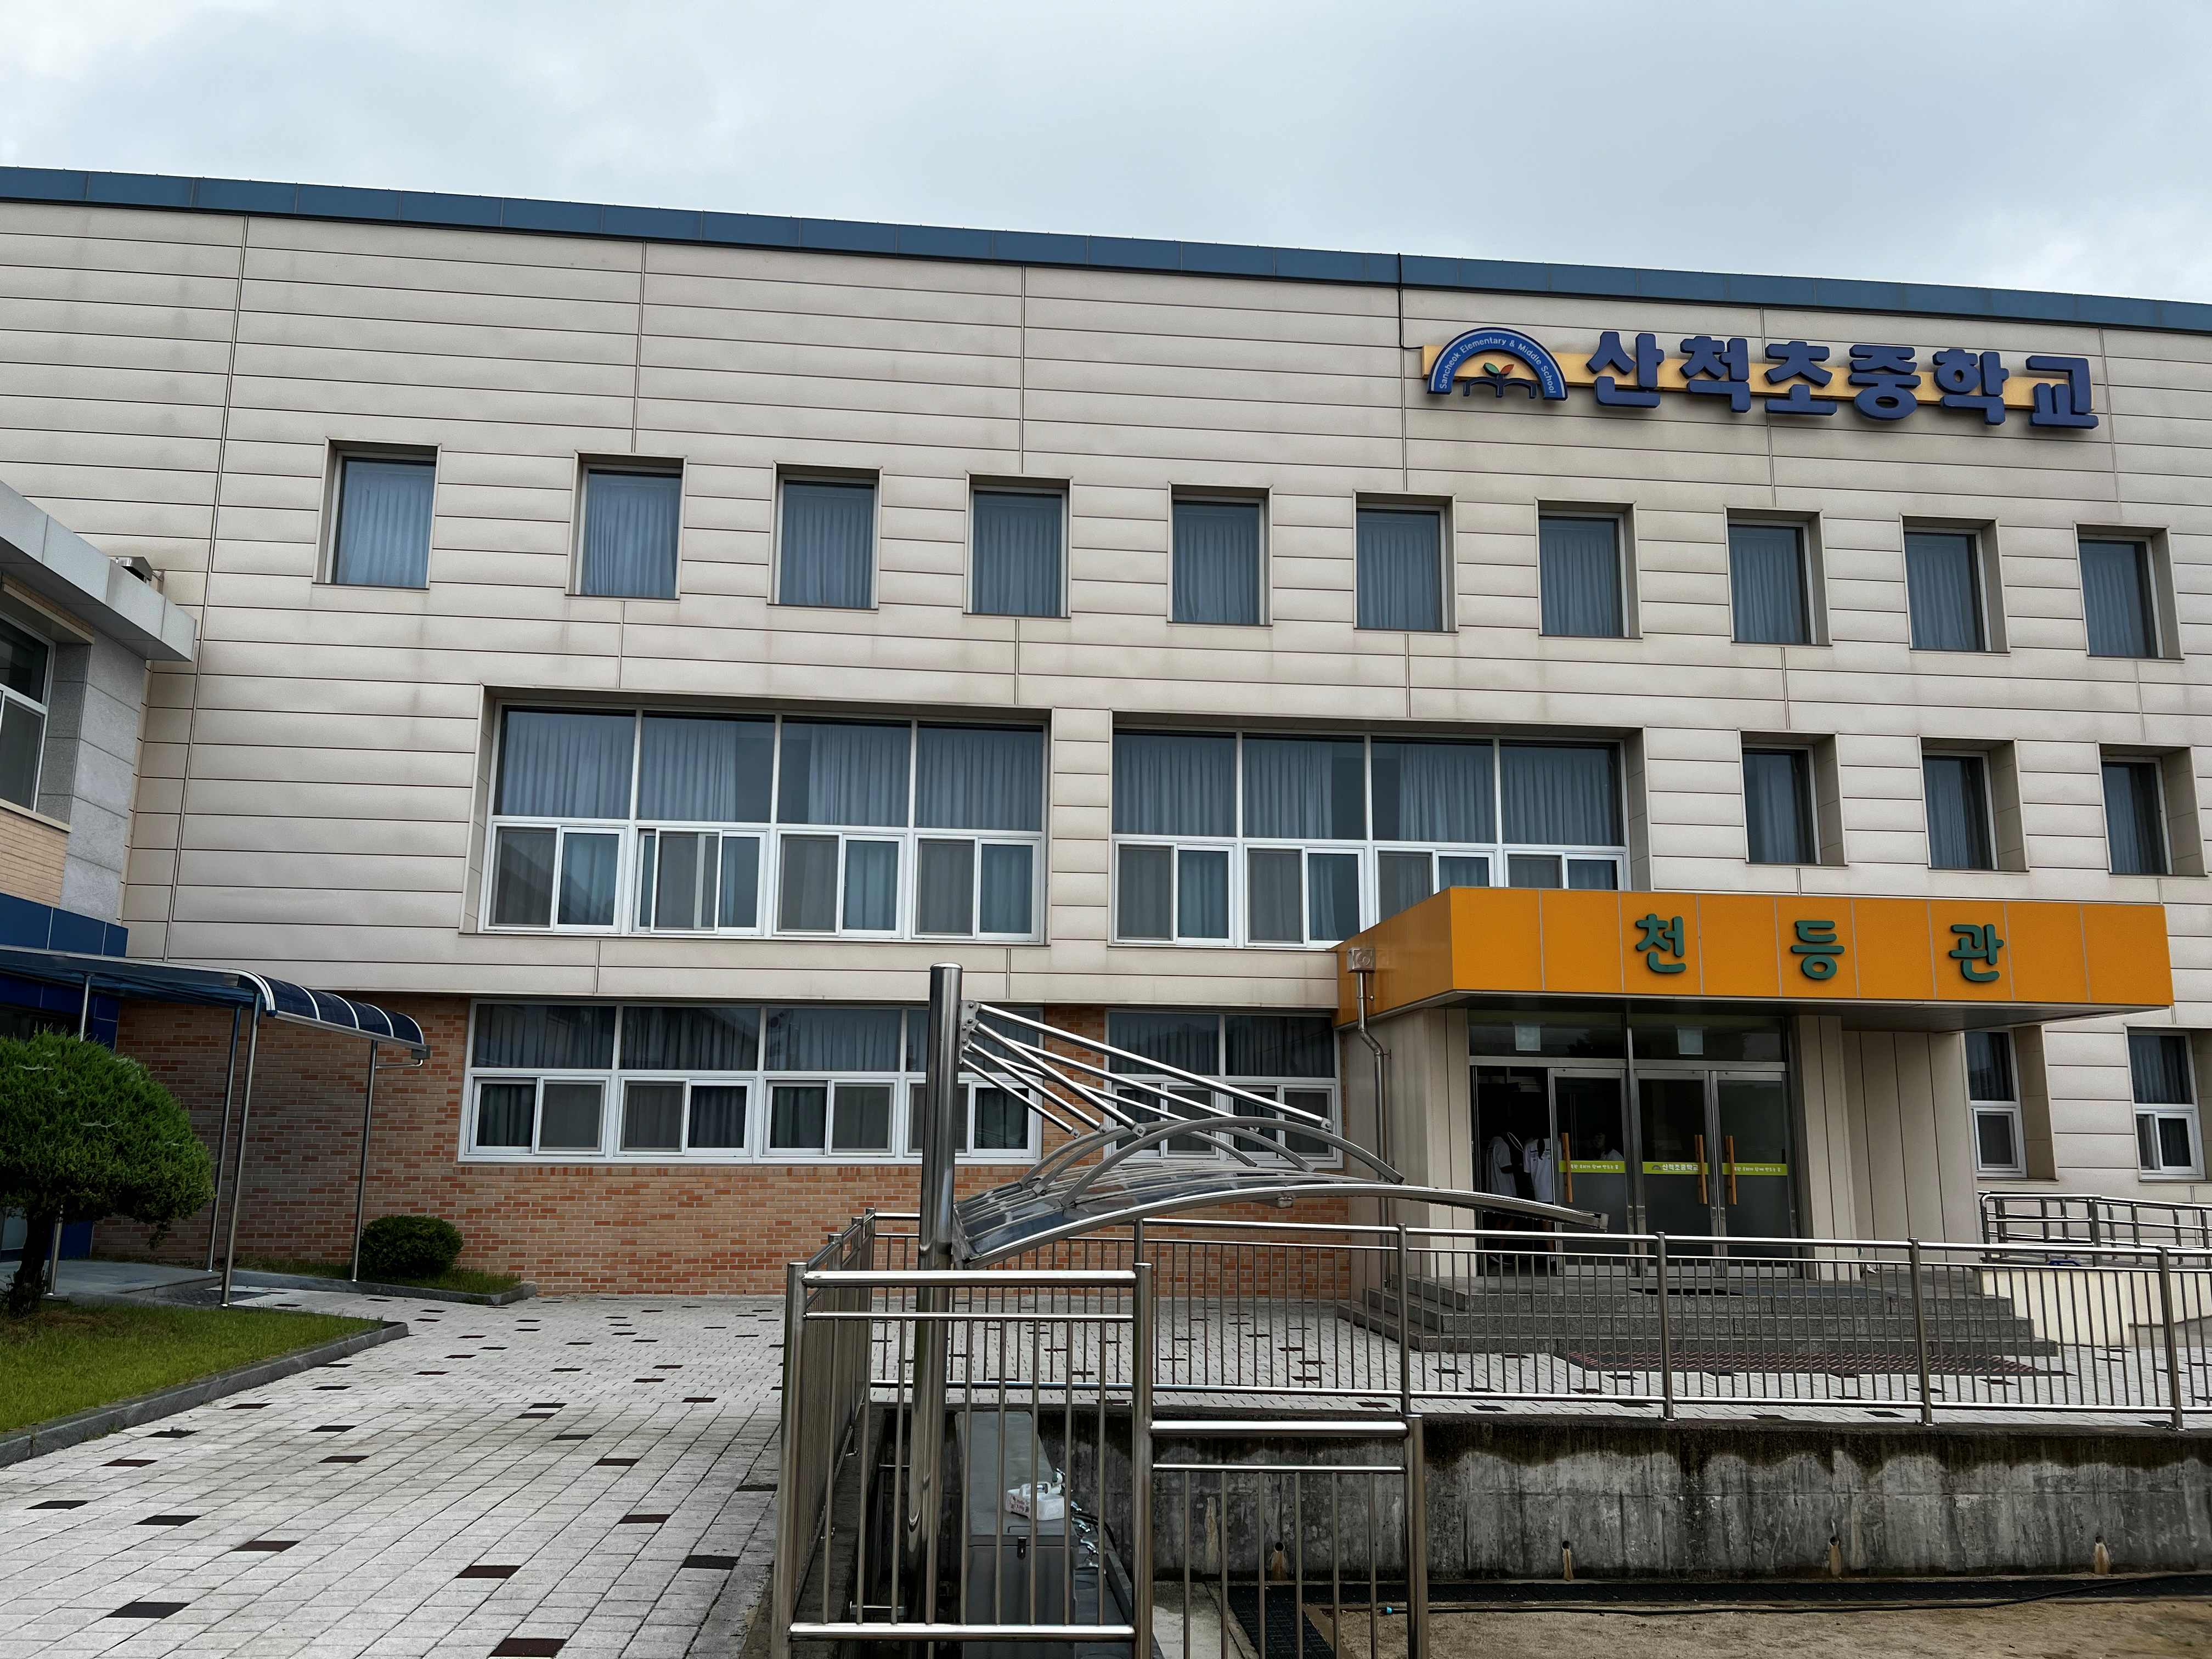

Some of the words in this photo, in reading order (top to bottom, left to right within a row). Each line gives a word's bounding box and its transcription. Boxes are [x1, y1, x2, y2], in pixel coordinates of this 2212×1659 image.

[1440, 352, 1461, 389] Sancheok
[1460, 337, 1506, 354] Elementary
[1517, 343, 1542, 365] Middle
[1541, 365, 1556, 393] School
[1585, 331, 2100, 430] 산척초중학교
